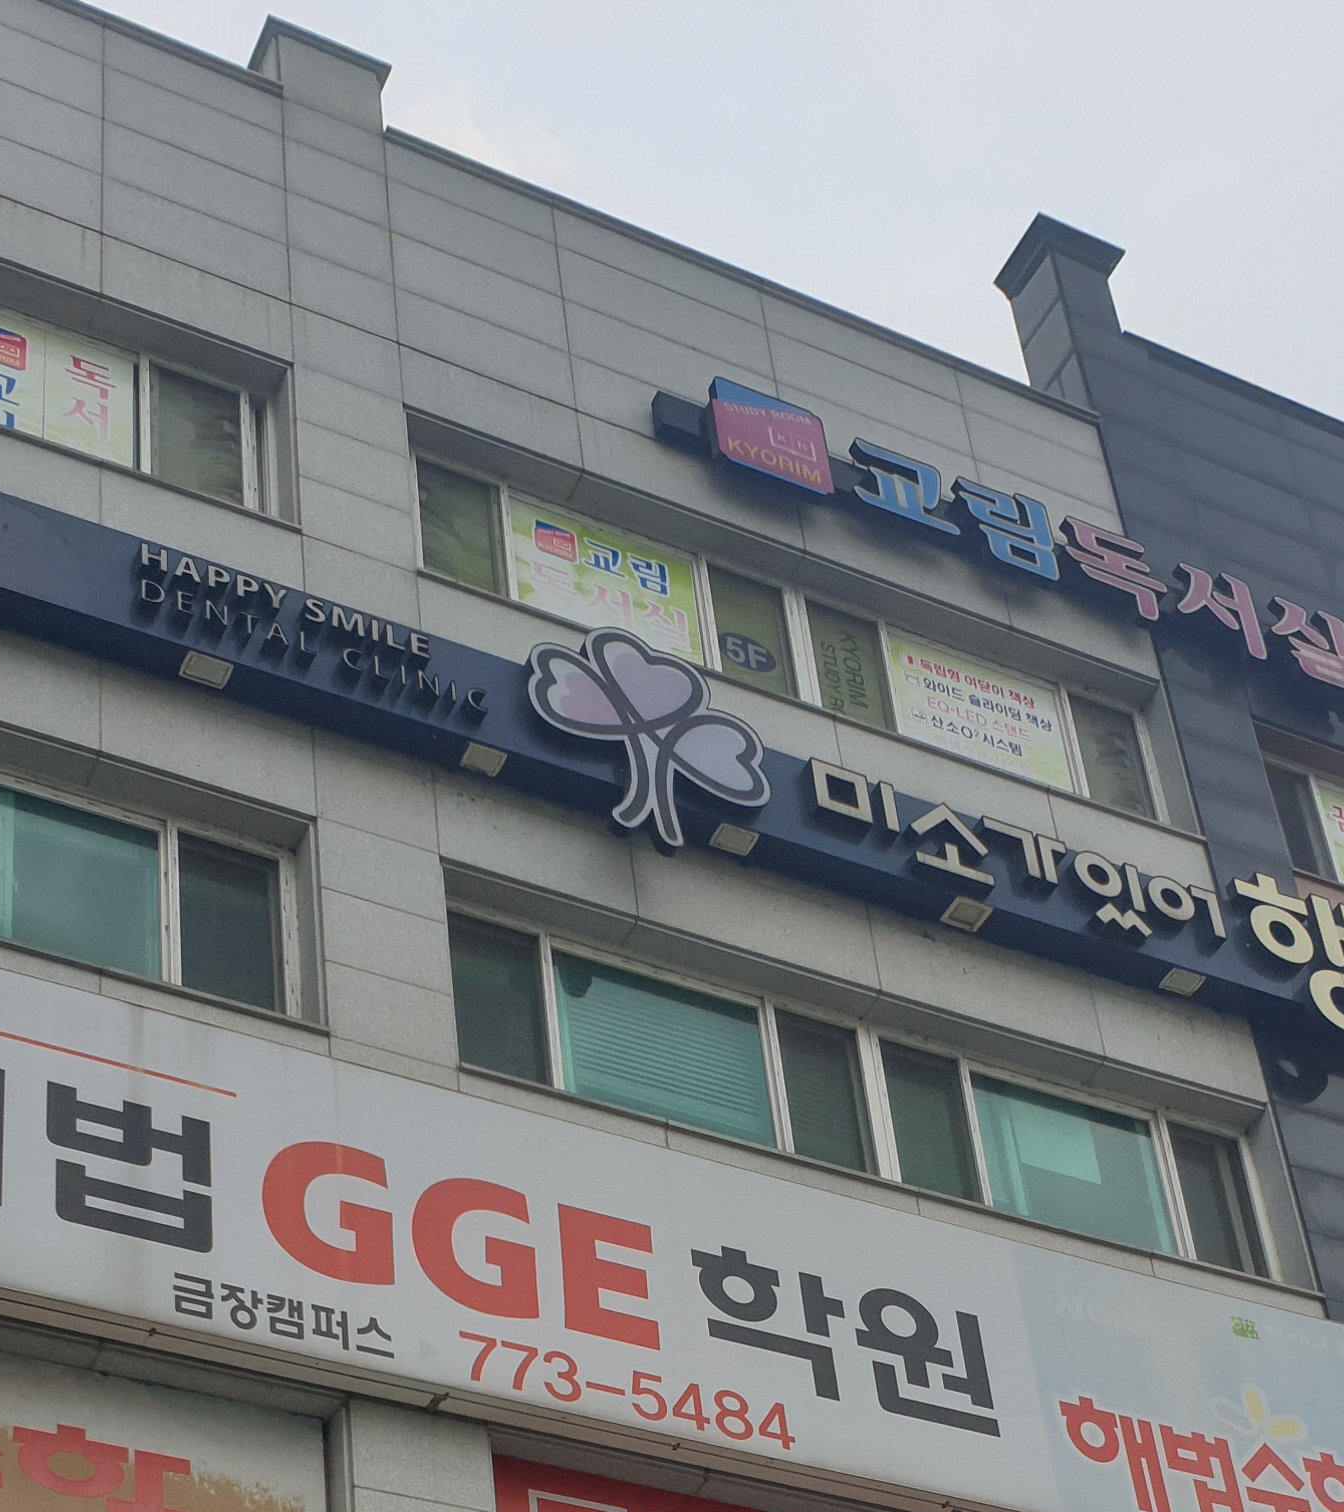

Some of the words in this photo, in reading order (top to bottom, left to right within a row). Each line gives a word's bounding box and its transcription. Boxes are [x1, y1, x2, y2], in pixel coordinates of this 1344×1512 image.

[726, 436, 823, 486] KYORIM
[139, 542, 288, 609] HAPPY
[305, 598, 432, 661] SMILE
[581, 538, 670, 598] 교림
[141, 577, 319, 656] DENTAL
[342, 648, 491, 713] CLINIC
[725, 635, 770, 669] 5F
[922, 676, 966, 703] 와이드
[982, 729, 1024, 758] 시스템
[170, 1270, 397, 1361] 금장캠퍼스
[260, 1139, 663, 1352] GGE
[689, 1244, 1002, 1440] 학원
[457, 1328, 798, 1452] 773-5484
